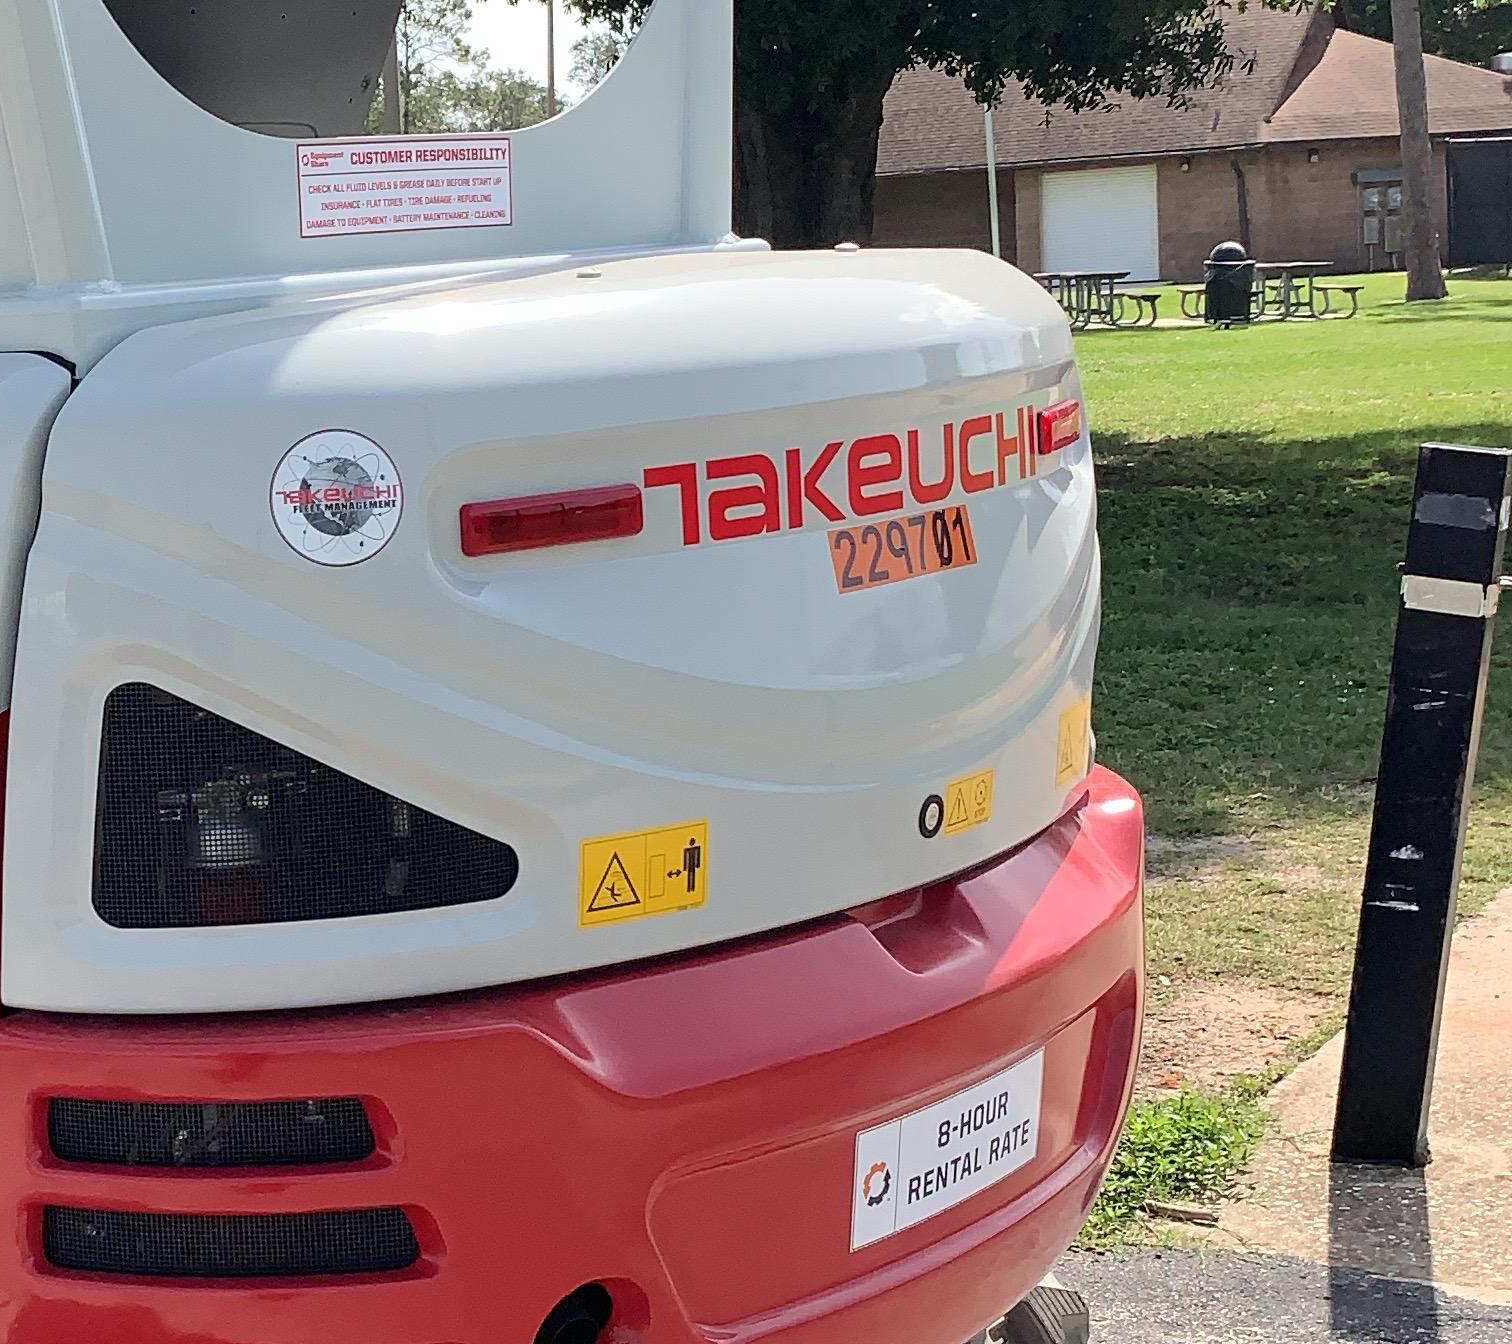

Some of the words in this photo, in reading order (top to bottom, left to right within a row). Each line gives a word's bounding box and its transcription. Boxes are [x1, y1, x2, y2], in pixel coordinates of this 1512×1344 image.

[350, 149, 413, 165] CUSTOMER
[415, 147, 507, 162] RESPONSIBILITY
[308, 185, 331, 194] CHECK
[333, 184, 344, 192] ALL
[347, 182, 366, 192] FLUID
[368, 181, 391, 191] LEVELS
[472, 177, 491, 186] START
[366, 199, 381, 208] FLAT
[337, 218, 346, 227] TO
[347, 216, 387, 226] EQUIPMENT
[393, 214, 421, 223] BATTERY
[643, 404, 1036, 547] TAKEUCHI
[293, 503, 321, 513] FLEET
[324, 499, 397, 511] MANAGEMENT
[834, 508, 972, 588] 229701
[938, 1091, 1008, 1148] 8-HOUR
[908, 1147, 982, 1204] RENTAL
[988, 1118, 1030, 1165] RATE
